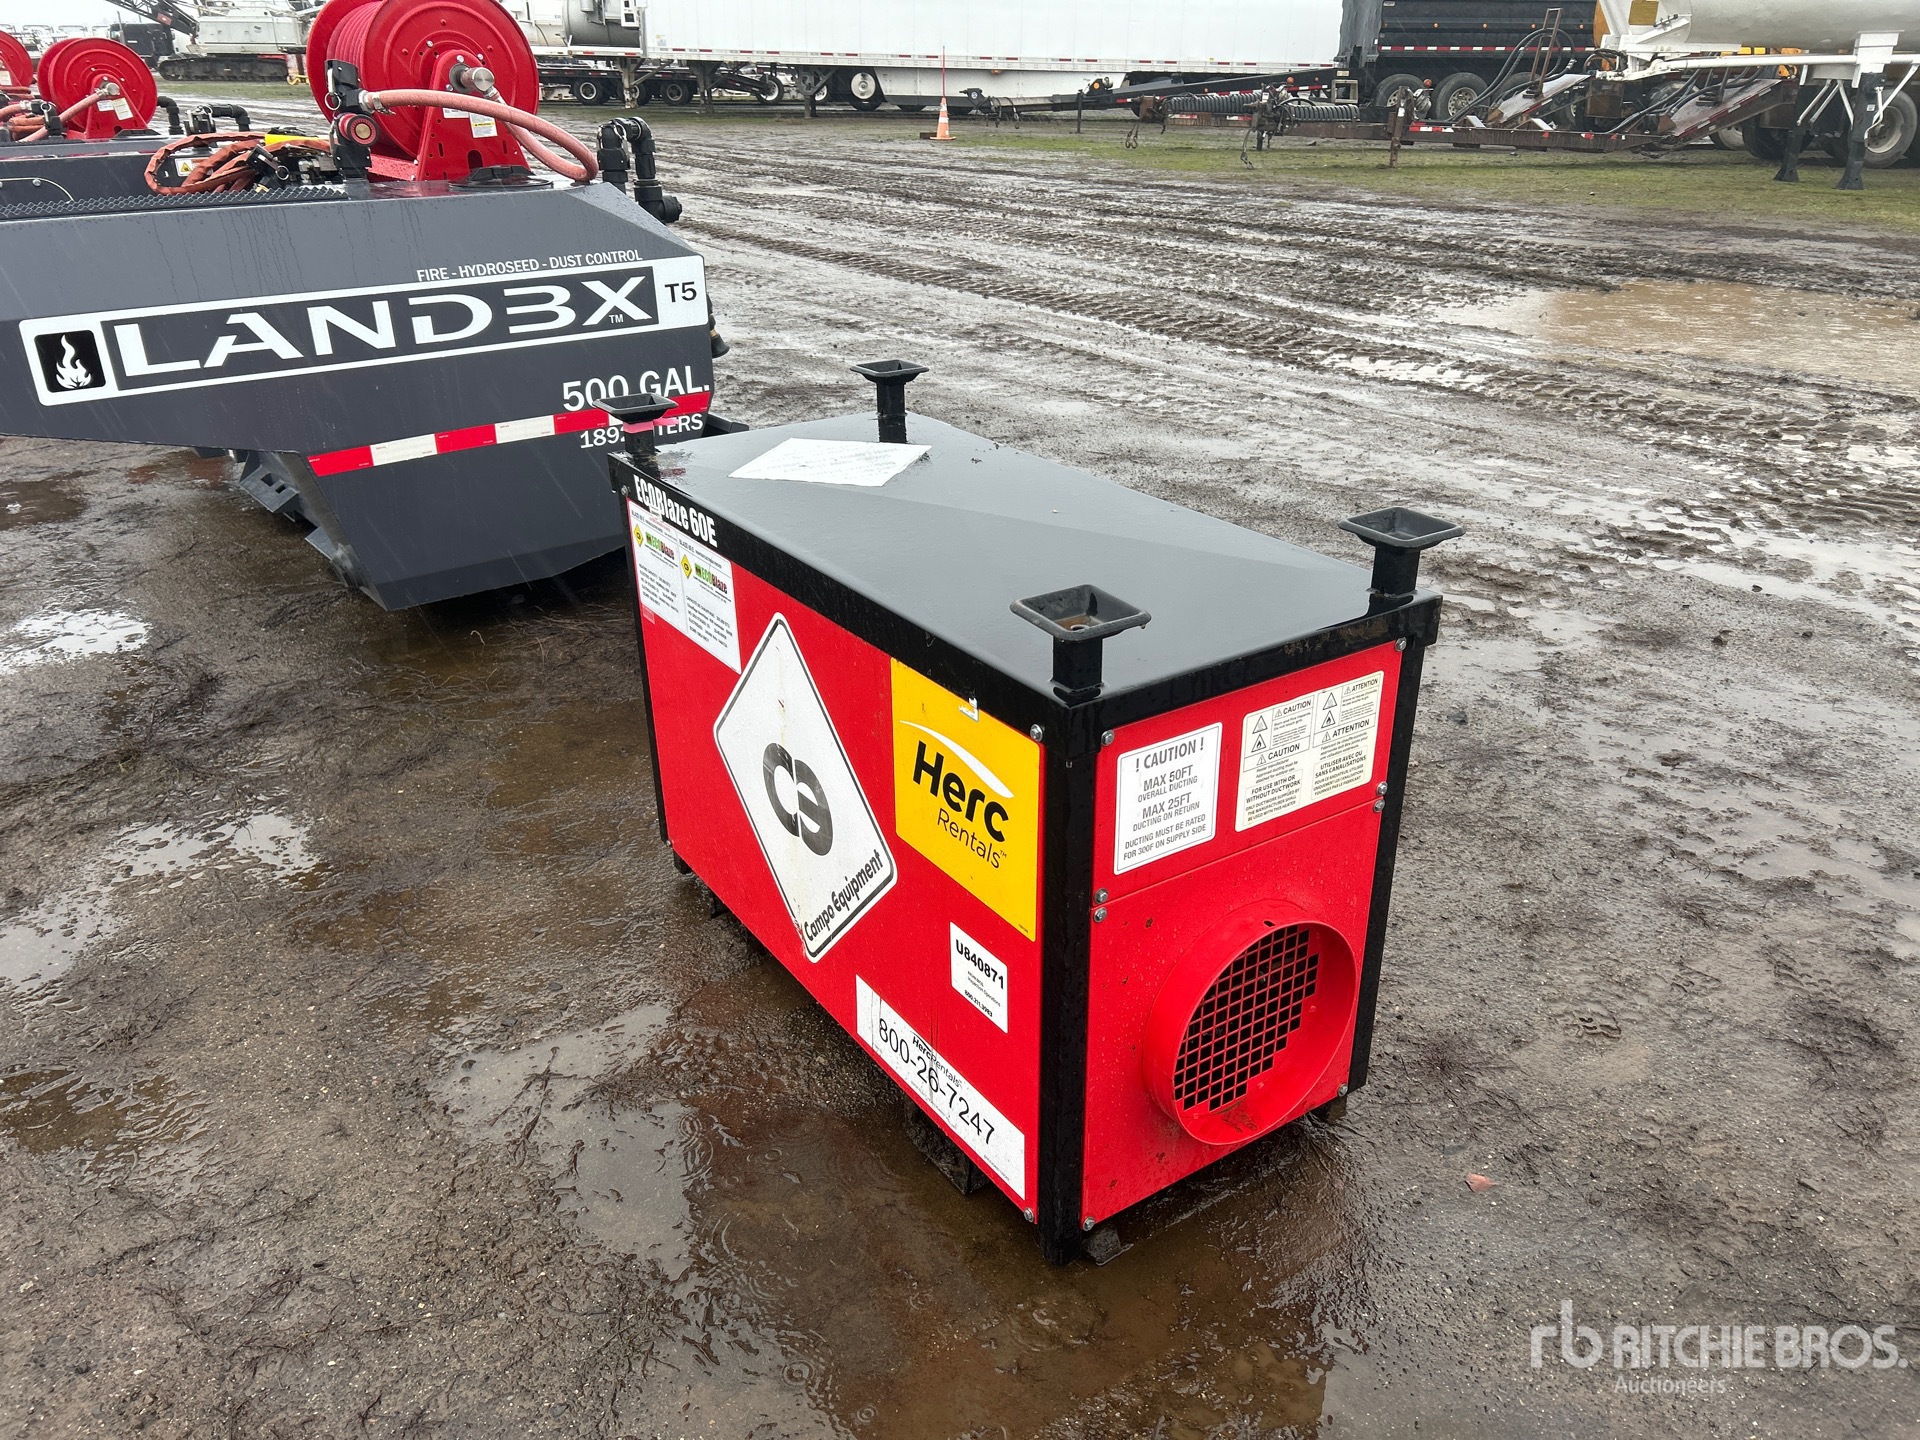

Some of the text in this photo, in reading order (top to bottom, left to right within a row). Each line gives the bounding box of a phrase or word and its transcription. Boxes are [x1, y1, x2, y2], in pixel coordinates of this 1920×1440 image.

[416, 267, 449, 282] FIRE
[459, 258, 539, 278] HYDROSEED
[550, 254, 583, 269] DUST
[585, 249, 643, 266] CONTROL
[665, 281, 698, 303] T5
[563, 365, 710, 412] 500 GAL.
[633, 474, 690, 531] ECOBlaze
[689, 507, 718, 548] 60E
[1352, 677, 1378, 692] ATTENTION
[1283, 699, 1312, 715] CAUTION
[1332, 718, 1370, 738] ATTENTION
[1144, 739, 1197, 769] CAUTION
[1268, 743, 1300, 761] CAUTION
[1315, 755, 1366, 778] SANS CANALISATIONS
[1320, 758, 1341, 770] UTILISER
[1342, 753, 1354, 762] AVEC
[912, 740, 1009, 843] Herc
[1138, 775, 1198, 803] OVERALL DUCTING
[1143, 765, 1193, 792] MAX 50FT
[1246, 779, 1300, 804] WITHOUT DUCTWORK
[1252, 786, 1262, 795] FOR
[1263, 782, 1273, 790] USE
[1274, 777, 1287, 786] WITH
[1132, 801, 1200, 832] DUCTING ON RETURN
[1142, 792, 1192, 819] MAX 25FT
[937, 808, 1000, 869] Rentals
[1123, 850, 1136, 861] FOR
[1155, 839, 1165, 849] ON
[1166, 830, 1190, 846] SUPPLY
[1192, 823, 1206, 836] SIDE
[1125, 814, 1206, 849] DUCTING MUST BE RATED
[804, 849, 884, 942] Campo Equipment
[956, 939, 1004, 989] U840871
[879, 1018, 995, 1144] 800-26-7247
